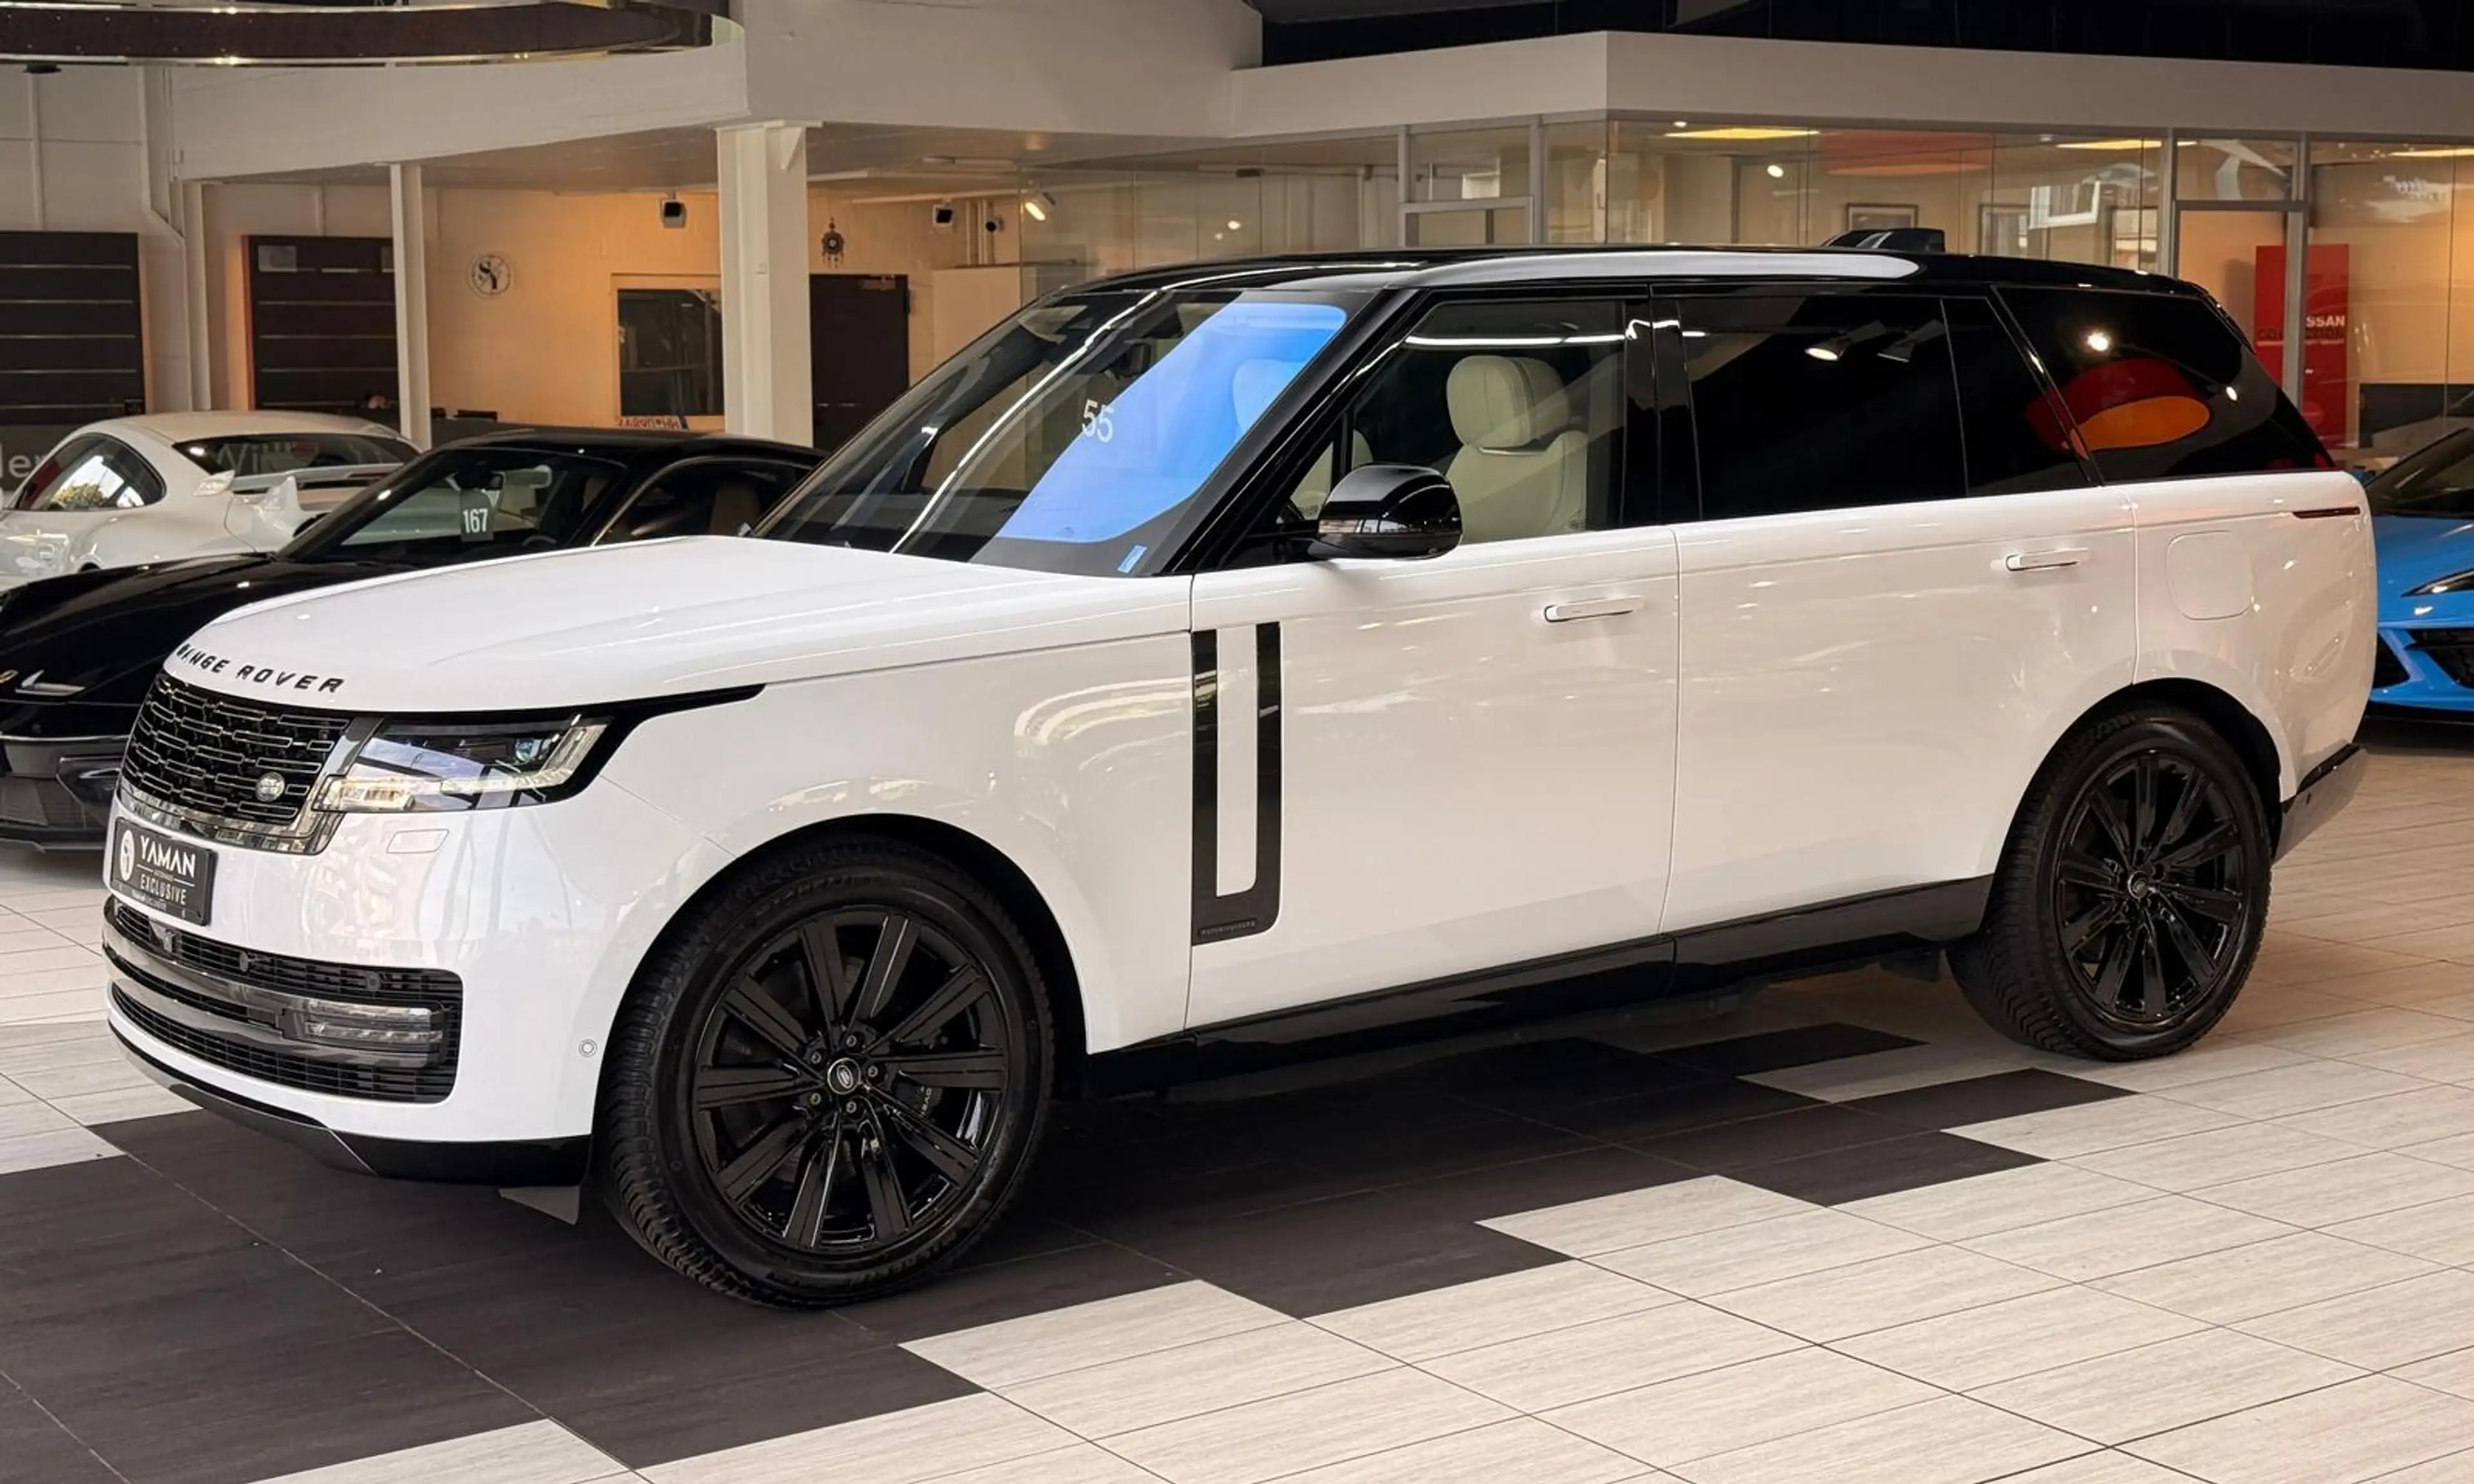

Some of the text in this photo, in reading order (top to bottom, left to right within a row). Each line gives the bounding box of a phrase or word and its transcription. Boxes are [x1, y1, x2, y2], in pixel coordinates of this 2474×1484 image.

[1081, 399, 1115, 442] 55
[463, 508, 488, 533] 167
[236, 665, 345, 693] ROVER
[140, 835, 196, 879] YAMAN
[139, 874, 187, 905] EXCLUSIVE
